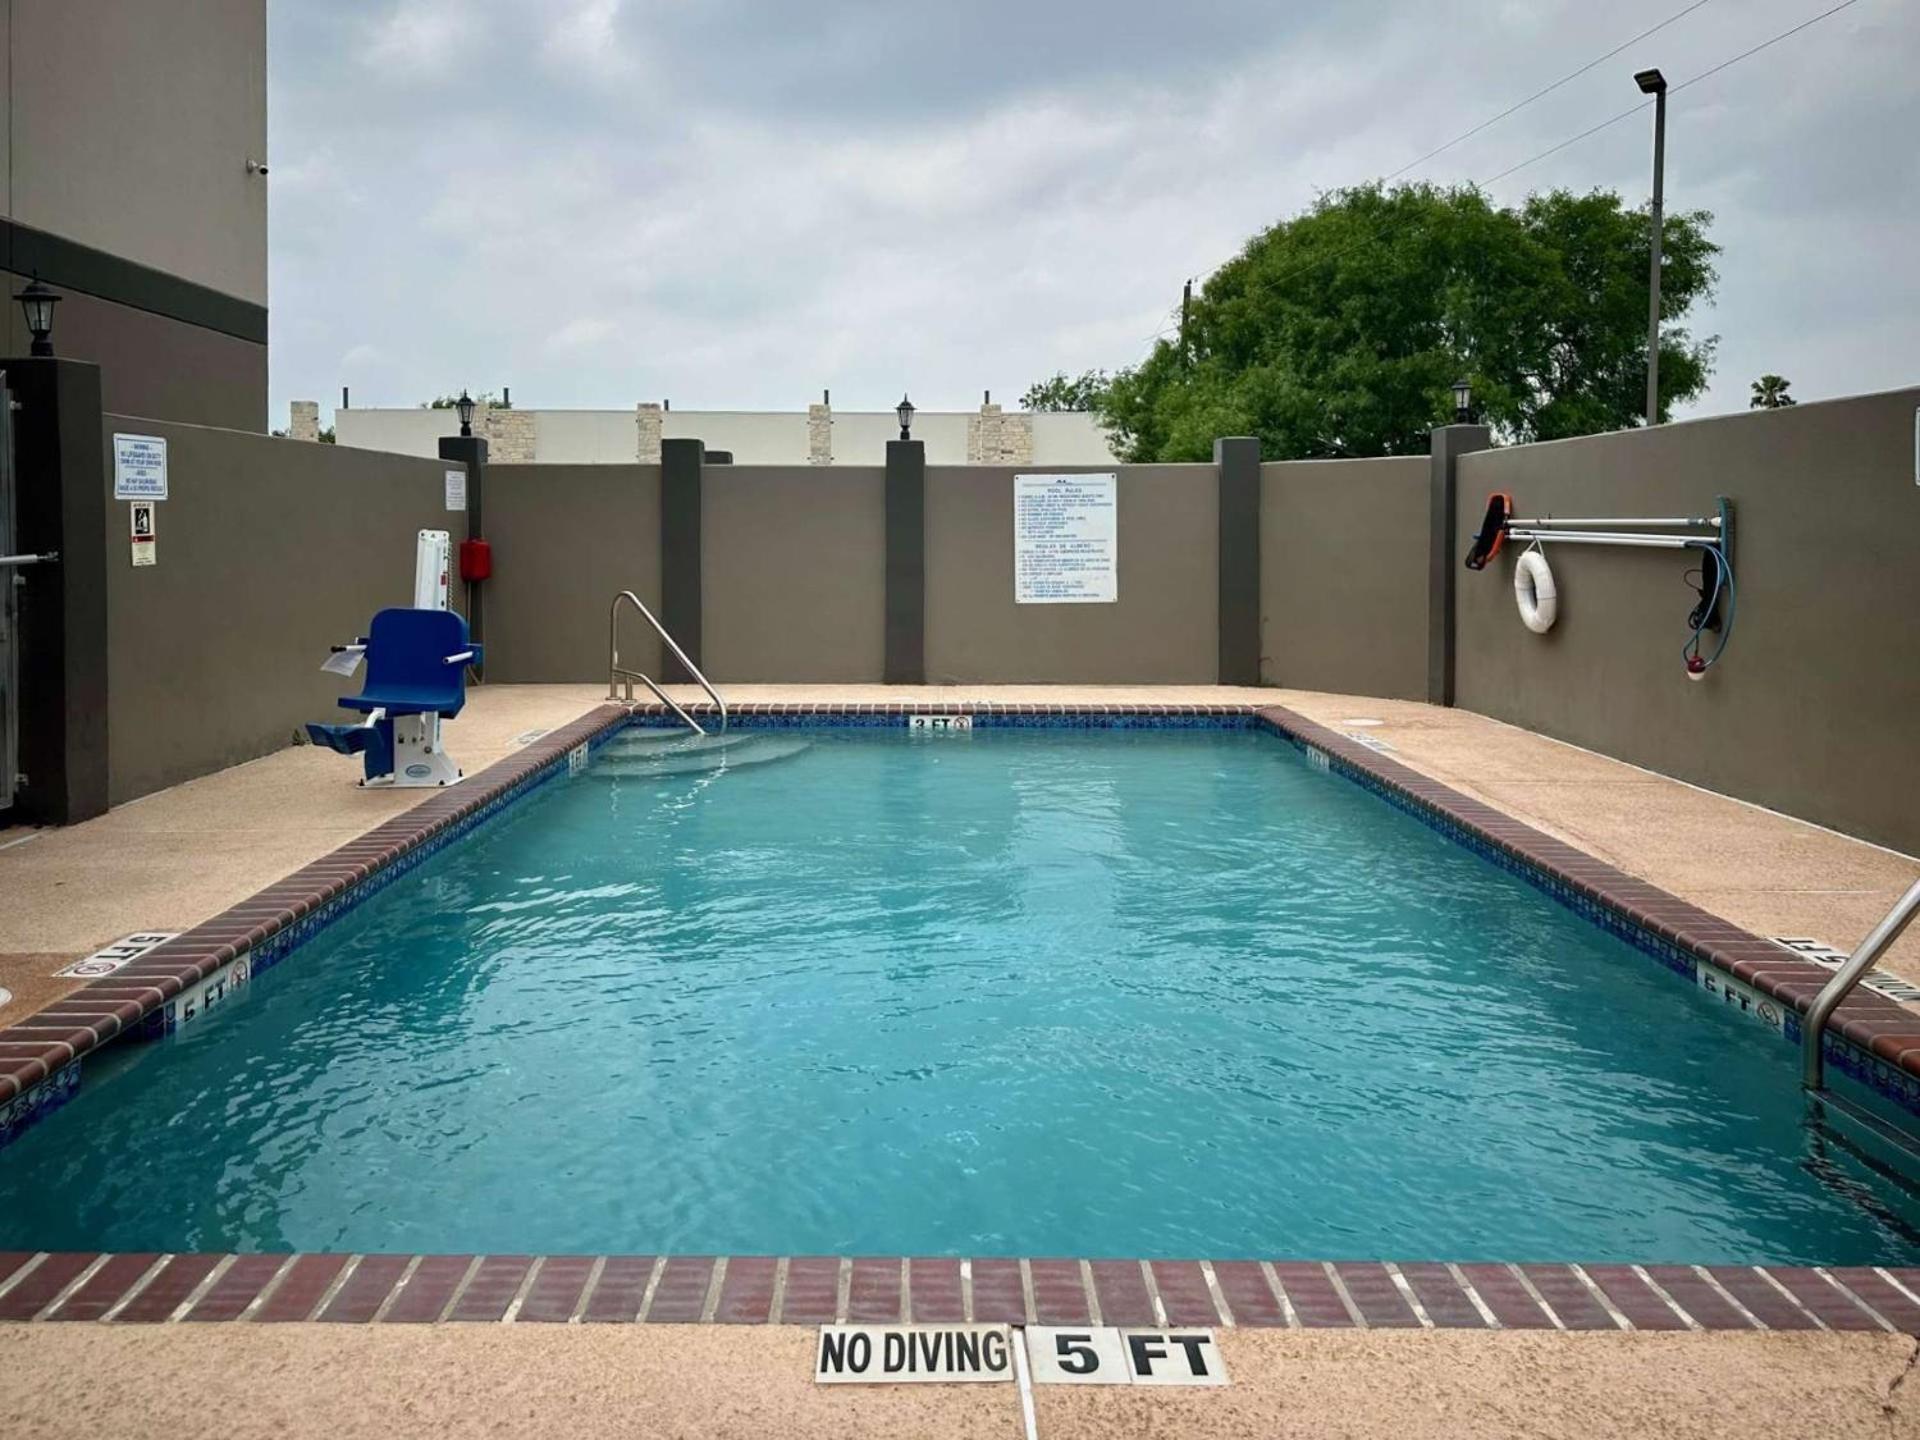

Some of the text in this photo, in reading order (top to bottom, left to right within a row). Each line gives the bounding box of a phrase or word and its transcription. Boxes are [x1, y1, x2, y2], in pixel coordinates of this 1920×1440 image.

[96, 946, 147, 960] FT
[820, 1330, 1008, 1374] NO DIVING
[1054, 1334, 1211, 1376] 5 FT
